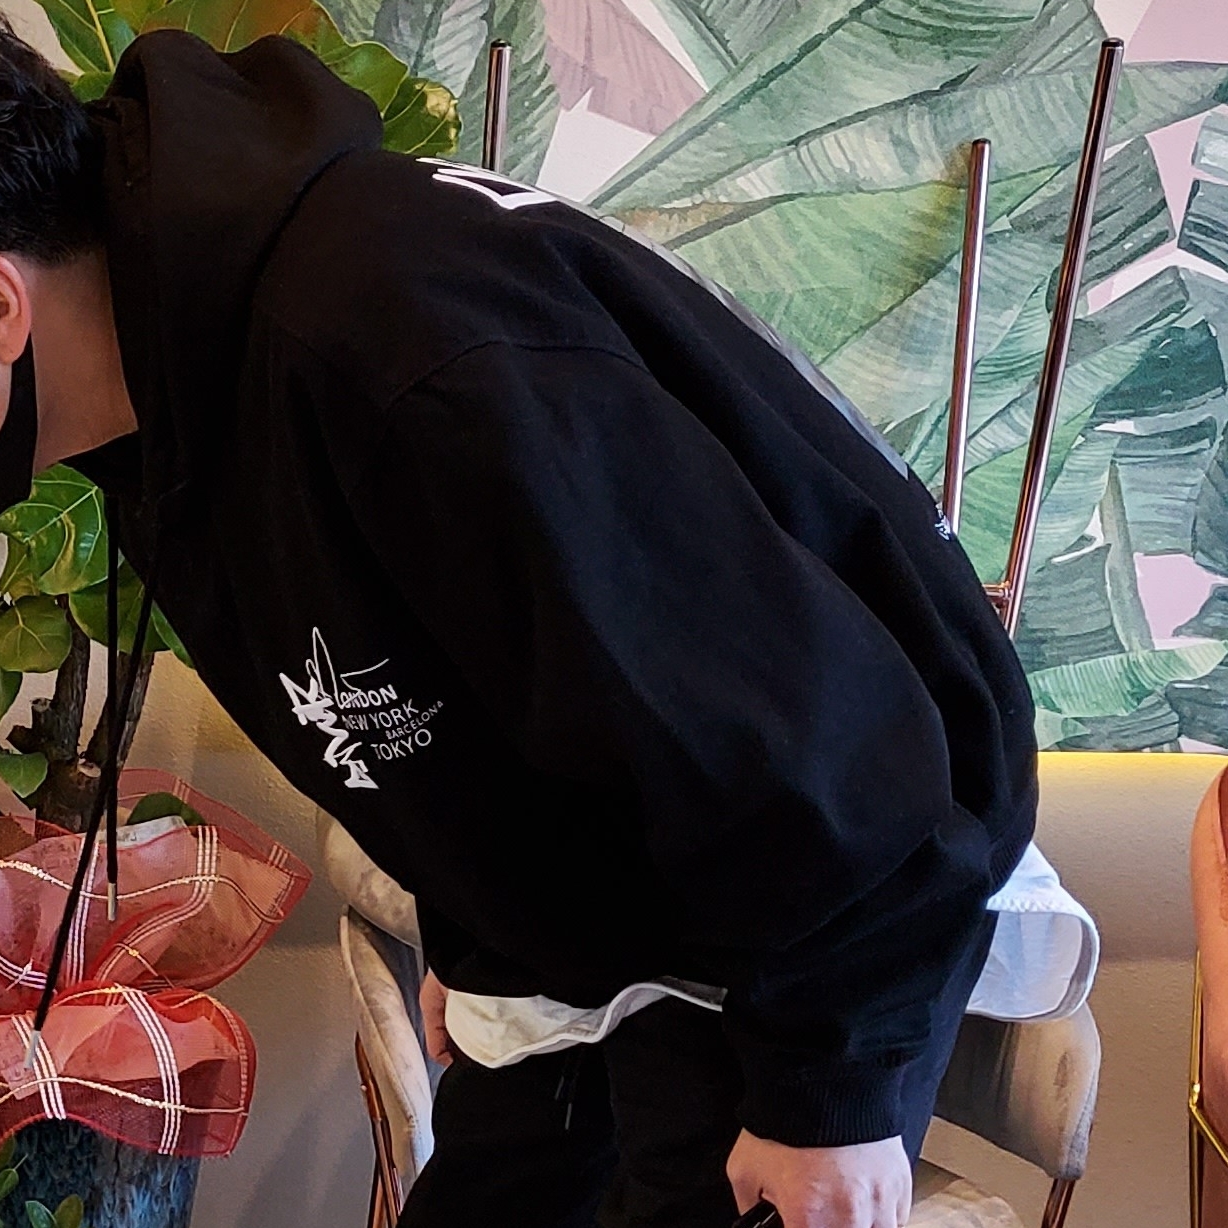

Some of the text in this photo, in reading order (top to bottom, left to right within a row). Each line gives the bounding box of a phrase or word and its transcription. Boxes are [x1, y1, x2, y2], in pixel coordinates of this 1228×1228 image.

[337, 684, 398, 709] LONDON
[342, 698, 419, 730] NEW YORK
[385, 700, 444, 740] BARCELONA
[370, 728, 432, 760] TOKYO
